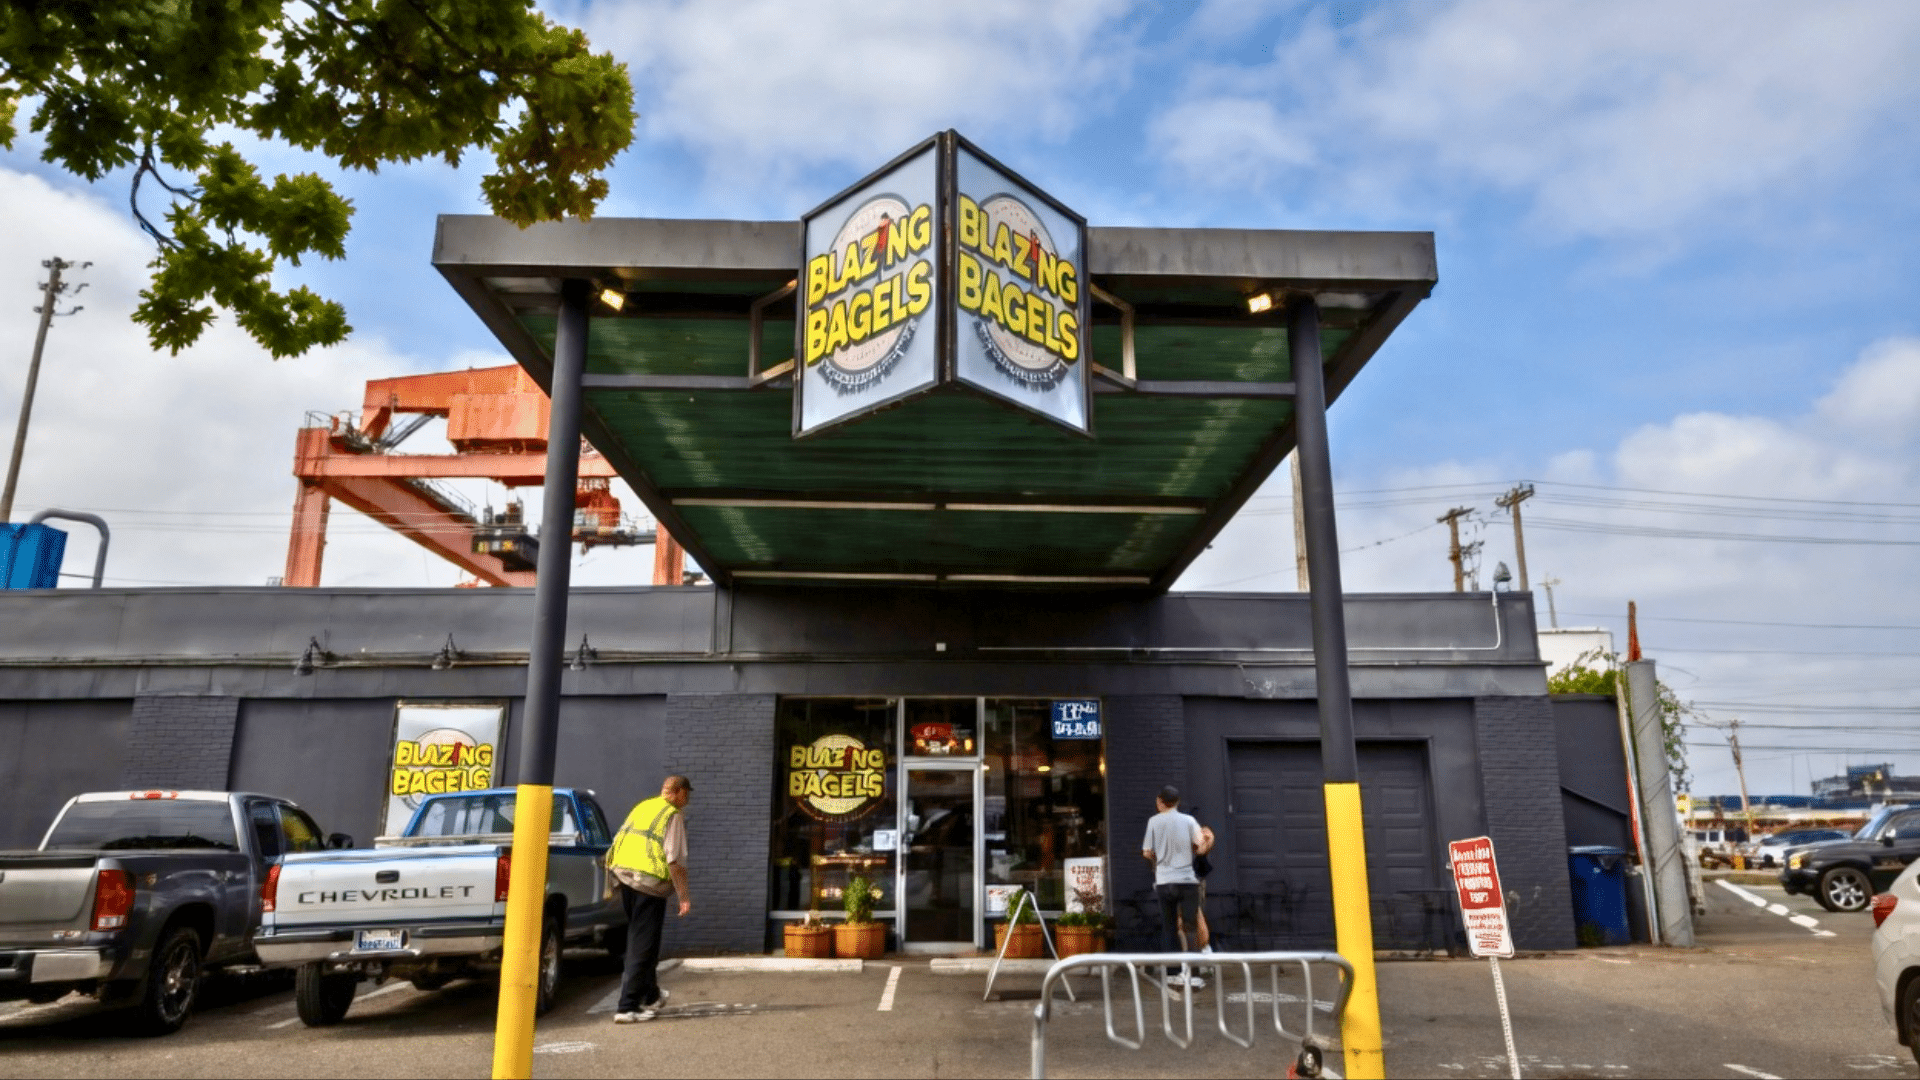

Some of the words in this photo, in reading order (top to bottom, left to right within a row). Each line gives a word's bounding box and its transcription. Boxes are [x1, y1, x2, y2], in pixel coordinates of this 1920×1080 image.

[807, 203, 931, 305] BLAZING
[958, 194, 1077, 303] BLAZING
[806, 259, 932, 366] BAGELS
[957, 251, 1079, 362] BAGELS
[392, 768, 491, 795] BAGELS
[789, 772, 883, 797] BAGELS
[298, 885, 475, 904] CHEVROLET
